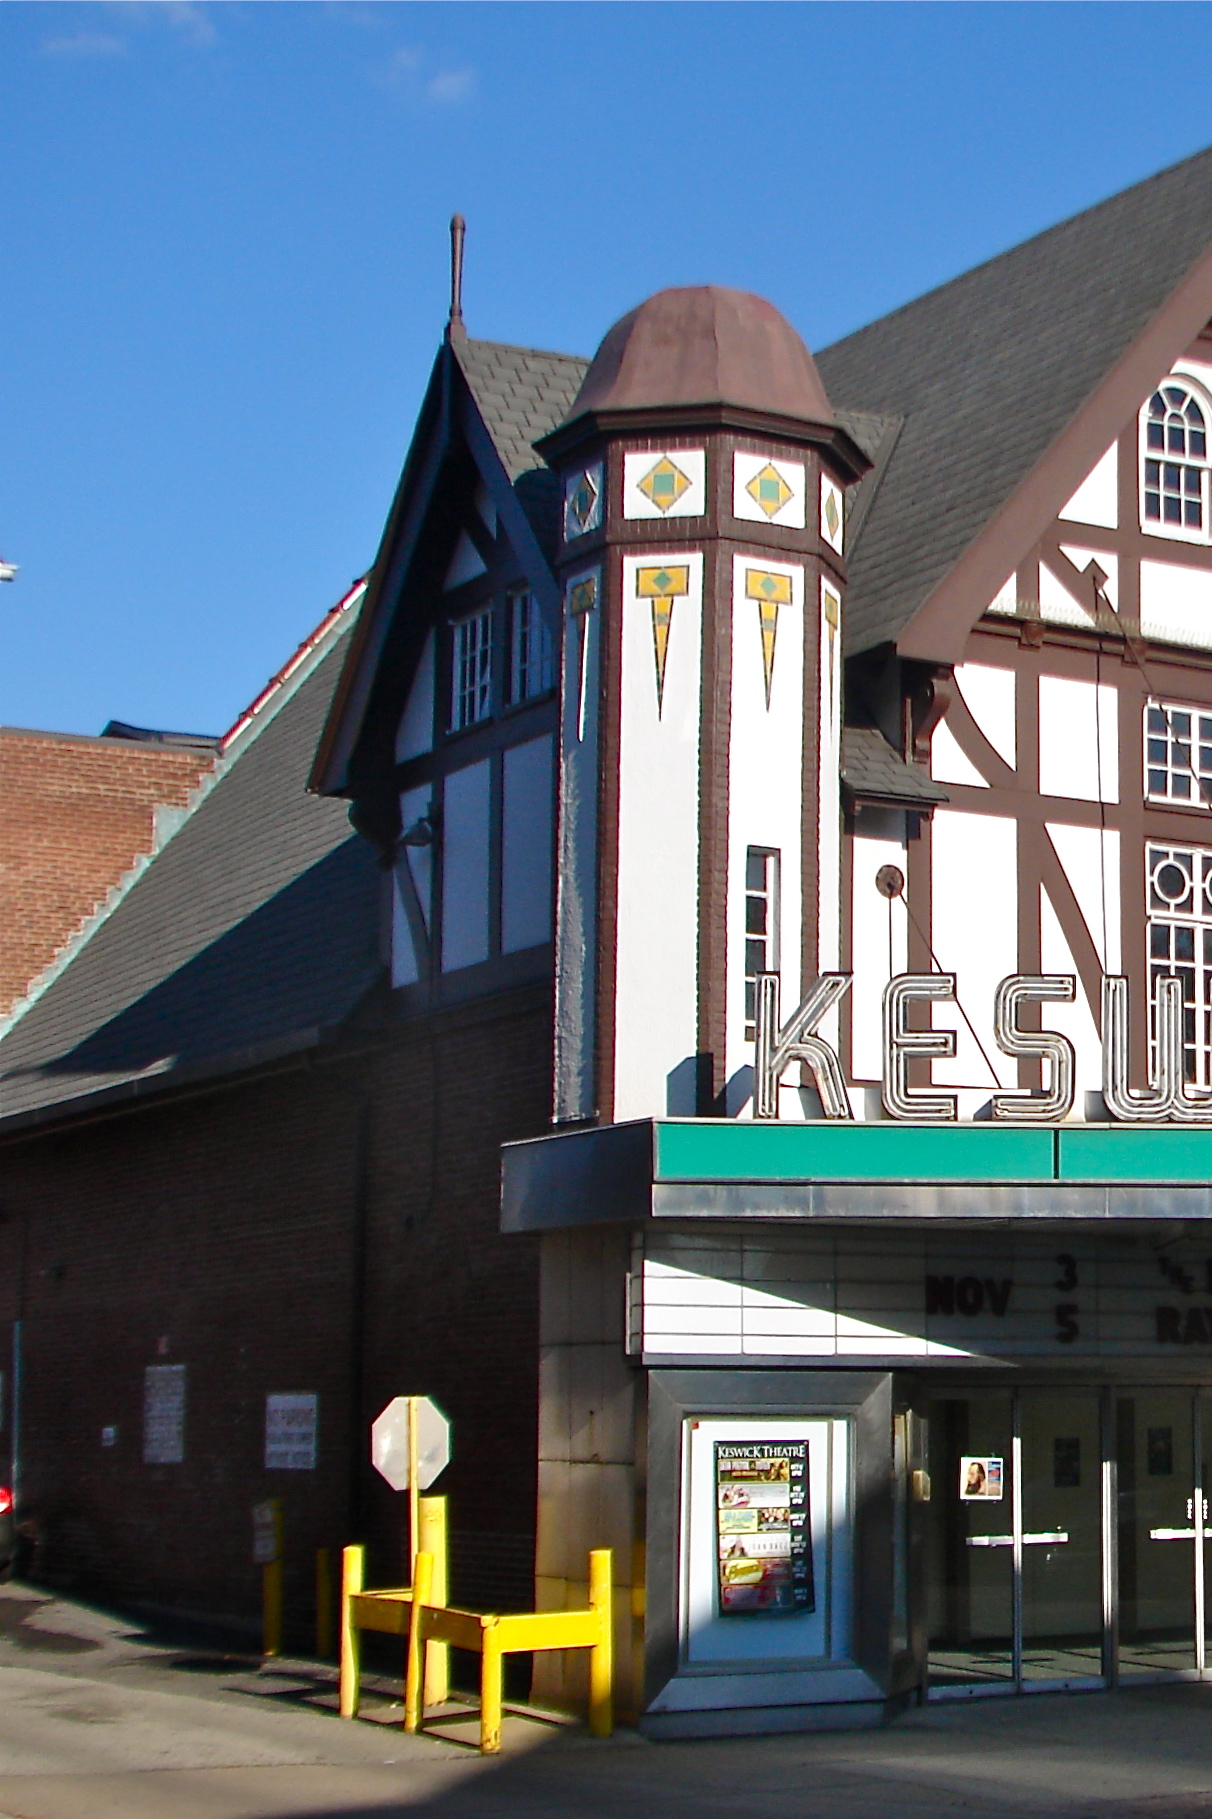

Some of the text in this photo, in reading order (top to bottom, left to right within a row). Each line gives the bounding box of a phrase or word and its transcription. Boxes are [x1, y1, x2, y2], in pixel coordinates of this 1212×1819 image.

[925, 1275, 1013, 1317] NOV
[1054, 1253, 1078, 1292] 3
[1054, 1303, 1080, 1344] 5
[718, 1445, 805, 1458] KESWICK THEATRE
